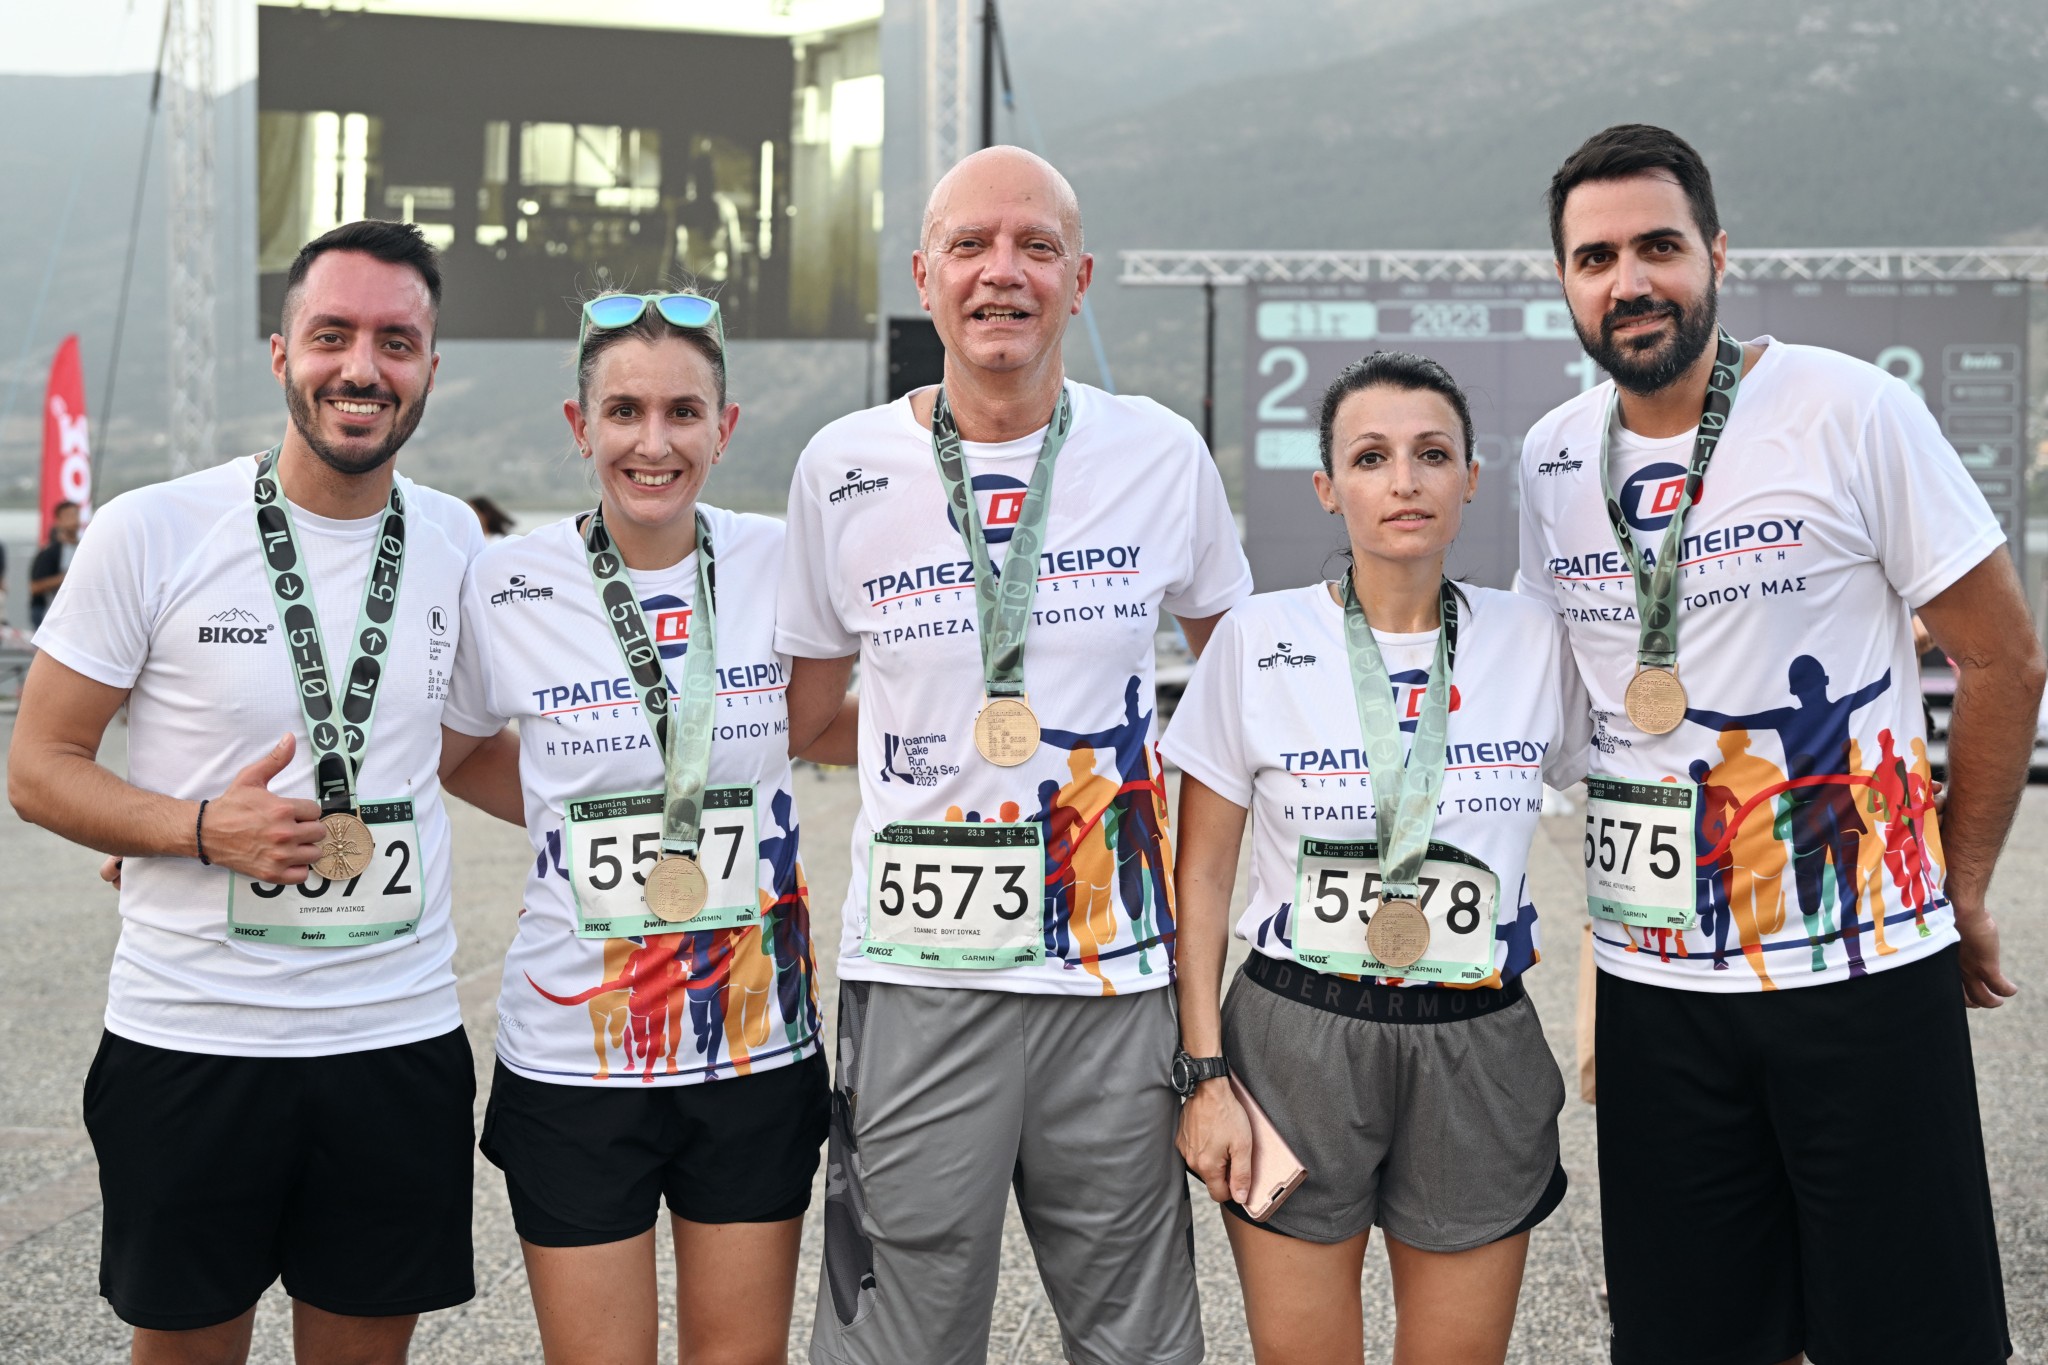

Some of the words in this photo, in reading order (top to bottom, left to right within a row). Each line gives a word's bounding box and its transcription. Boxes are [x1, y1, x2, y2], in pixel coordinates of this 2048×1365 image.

[1410, 304, 1490, 335] 2023
[1257, 346, 1308, 421] 2
[1038, 546, 1141, 576] ΠΕΙΡΟΥ
[1684, 584, 1751, 611] ΤΟΠΟΥ
[1761, 577, 1806, 597] ΜΑΣ
[883, 618, 975, 645] ΤΡΑΠΕΖΑ
[1032, 605, 1105, 626] ΤΟΠΟΥ
[1114, 602, 1148, 619] ΜΑΣ
[563, 734, 652, 756] ΤΡΑΠΕΖΑ
[902, 733, 947, 747] Ioannina
[904, 745, 929, 756] Lake
[908, 756, 927, 766] Run
[910, 766, 939, 776] 23-24
[940, 764, 960, 776] Sep
[915, 776, 938, 787] 2023
[1631, 785, 1647, 794] 23.9
[1679, 789, 1689, 798] km
[588, 800, 627, 810] Ioannina
[631, 797, 652, 805] Lake
[1662, 797, 1668, 805] 5
[1677, 797, 1688, 806] km
[361, 806, 379, 814] 23.9
[589, 810, 604, 818] Run
[607, 807, 628, 816] 2023
[1284, 805, 1294, 820] Η
[1455, 797, 1521, 814] ΤΟΠΟΥ
[917, 827, 935, 835] Lake
[967, 829, 986, 837] 23.9
[1023, 828, 1035, 836] km
[895, 835, 913, 843] 2023
[1006, 837, 1012, 845] 5
[1024, 837, 1036, 845] km
[879, 862, 1029, 920] 5573
[690, 915, 722, 923] GARMIN
[1622, 909, 1648, 919] GARMIN
[643, 919, 667, 929] bwin
[301, 931, 326, 940] bwin
[348, 930, 380, 938] GARMIN
[962, 954, 995, 962] GARMIN
[1408, 965, 1442, 974] GARMIN
[1461, 971, 1482, 979] PUMA
